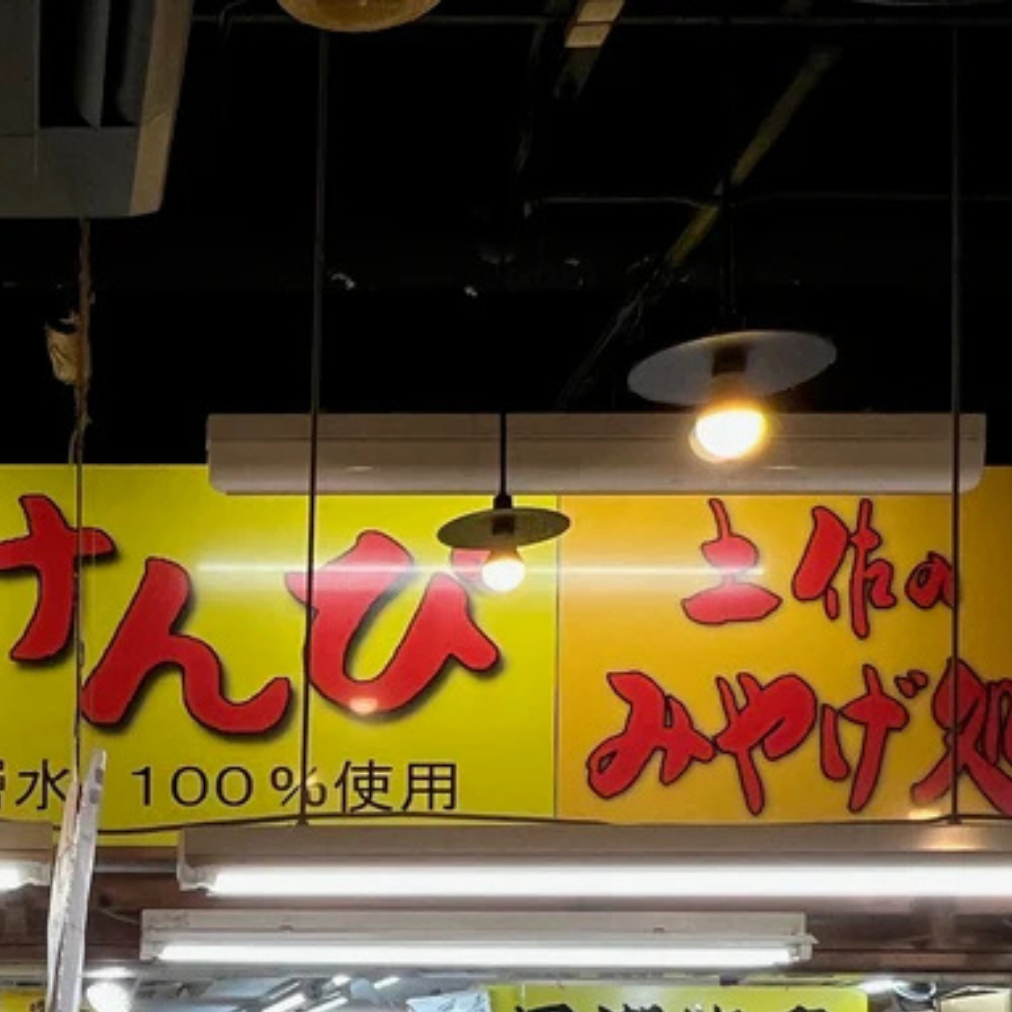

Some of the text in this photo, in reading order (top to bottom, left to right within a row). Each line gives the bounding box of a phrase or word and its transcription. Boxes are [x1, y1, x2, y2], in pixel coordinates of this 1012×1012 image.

[681, 498, 960, 640] 土佐の
[131, 760, 458, 812] 100%使用
